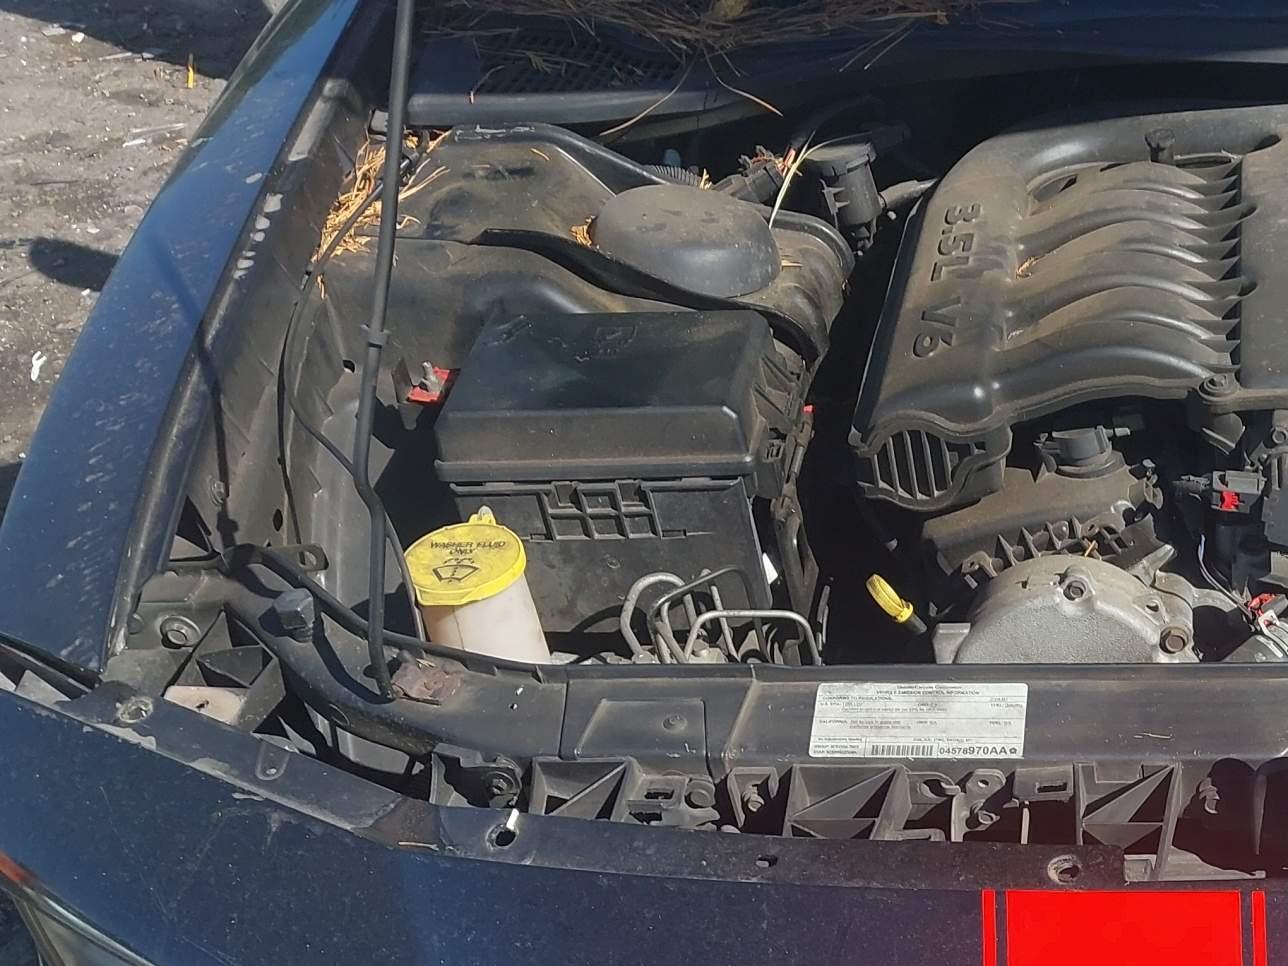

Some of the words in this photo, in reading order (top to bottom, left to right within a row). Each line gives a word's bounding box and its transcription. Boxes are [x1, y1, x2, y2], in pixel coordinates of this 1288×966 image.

[930, 203, 981, 282] 3.5L
[912, 296, 962, 359] V6
[430, 541, 474, 549] WASHER
[476, 541, 506, 549] FLUID
